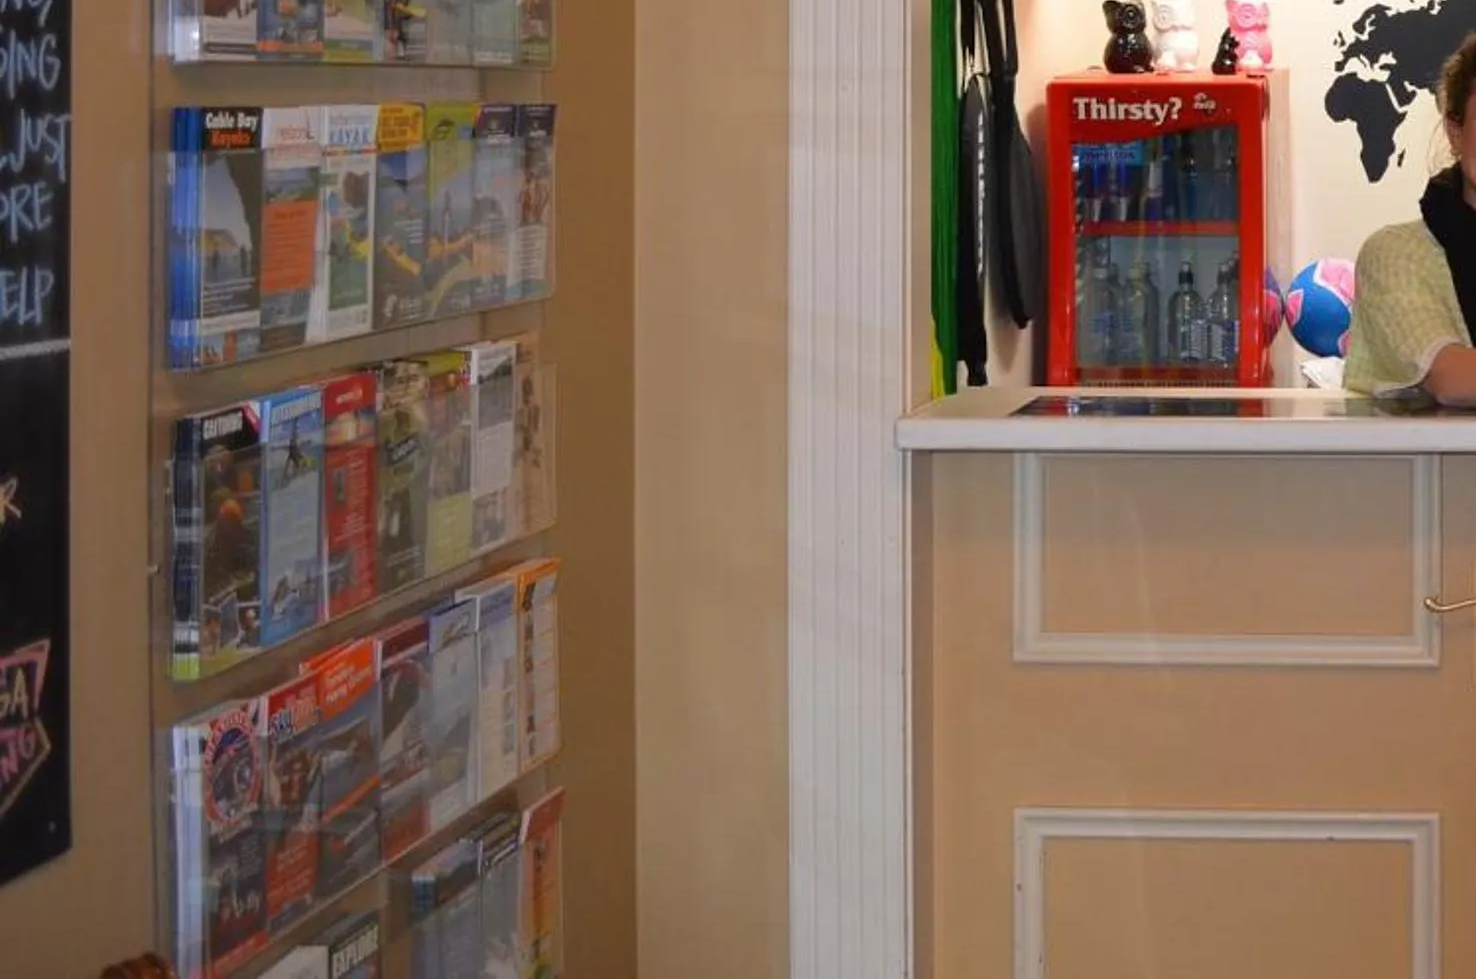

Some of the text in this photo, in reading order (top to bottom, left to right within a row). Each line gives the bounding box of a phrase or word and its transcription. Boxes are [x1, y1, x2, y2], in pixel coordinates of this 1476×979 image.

[237, 110, 260, 132] Bay
[1073, 96, 1182, 126] Thirsty?
[332, 924, 379, 979] EXPLORE
